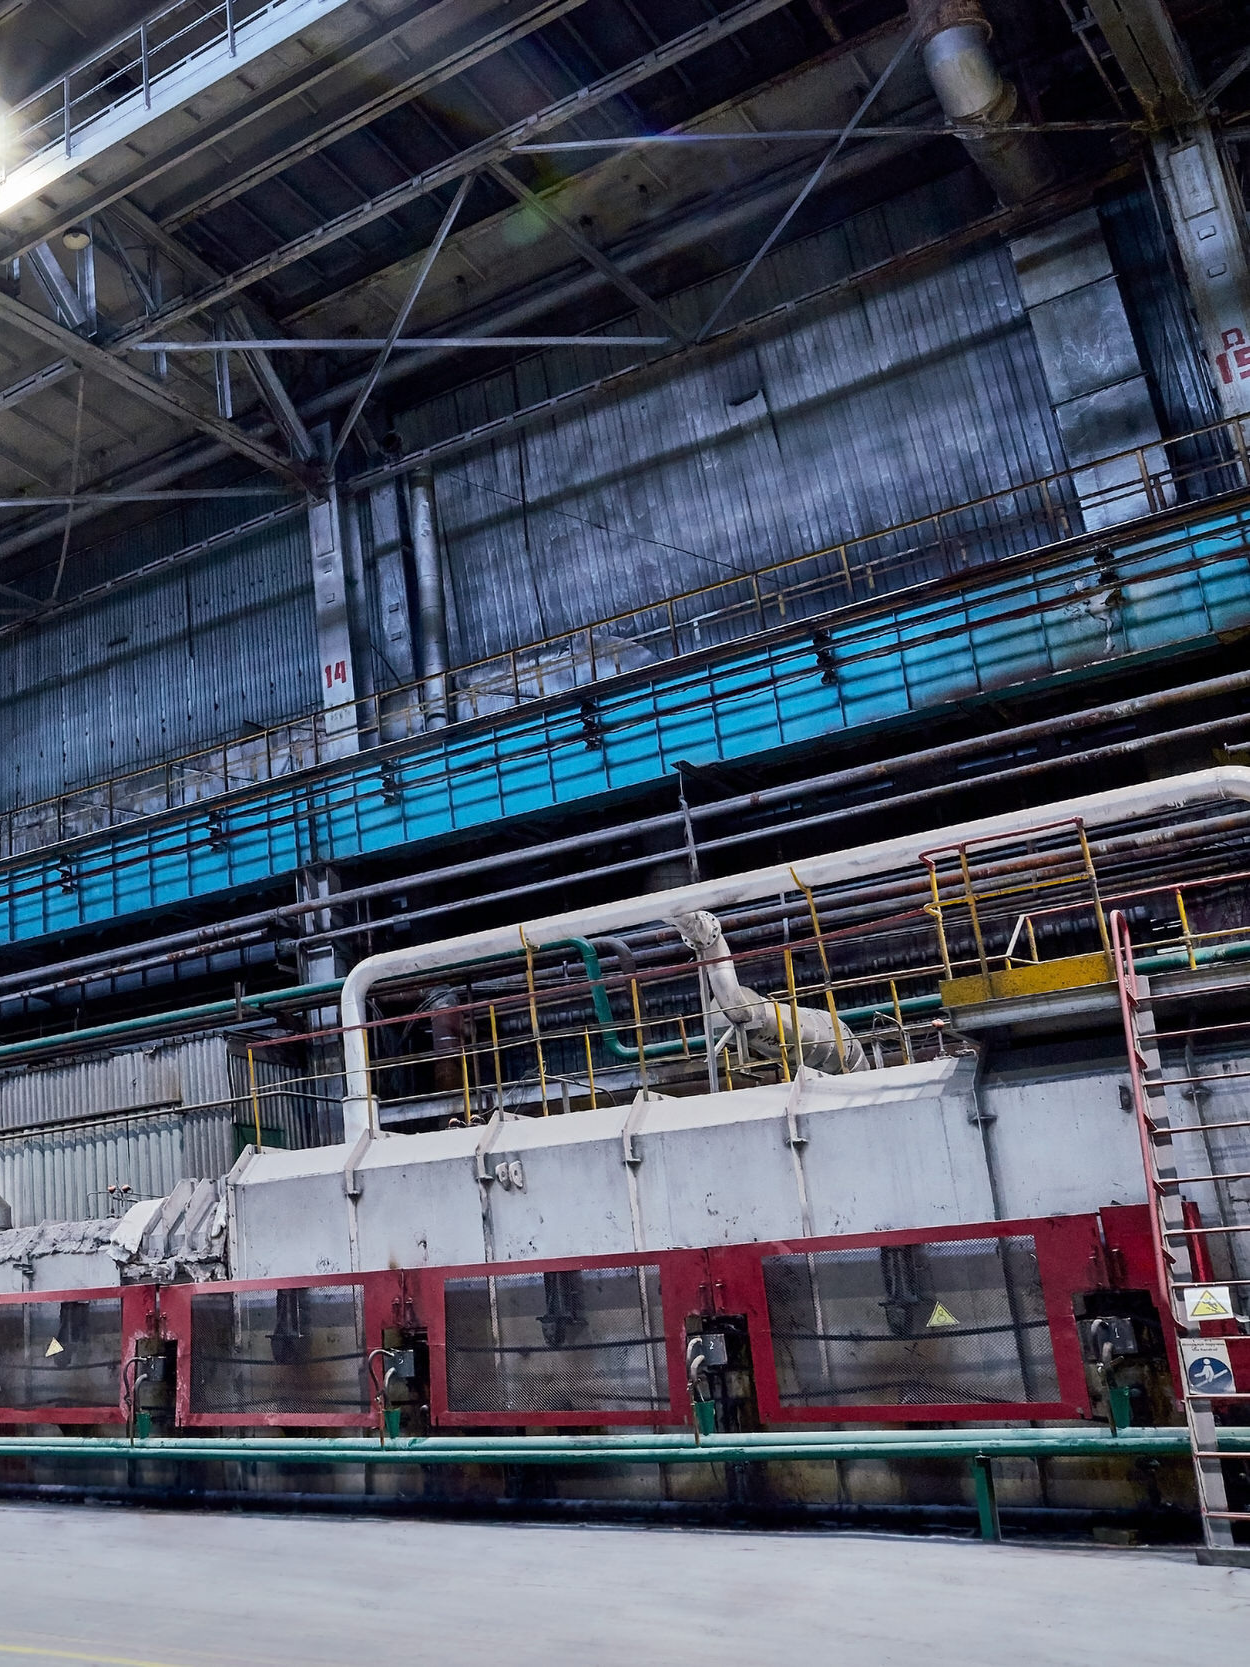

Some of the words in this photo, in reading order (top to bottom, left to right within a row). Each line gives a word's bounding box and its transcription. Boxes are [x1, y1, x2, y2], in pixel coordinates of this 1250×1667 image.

[1216, 347, 1250, 384] 15
[324, 660, 347, 688] 14
[1114, 1327, 1120, 1338] 1
[709, 1340, 714, 1350] 2
